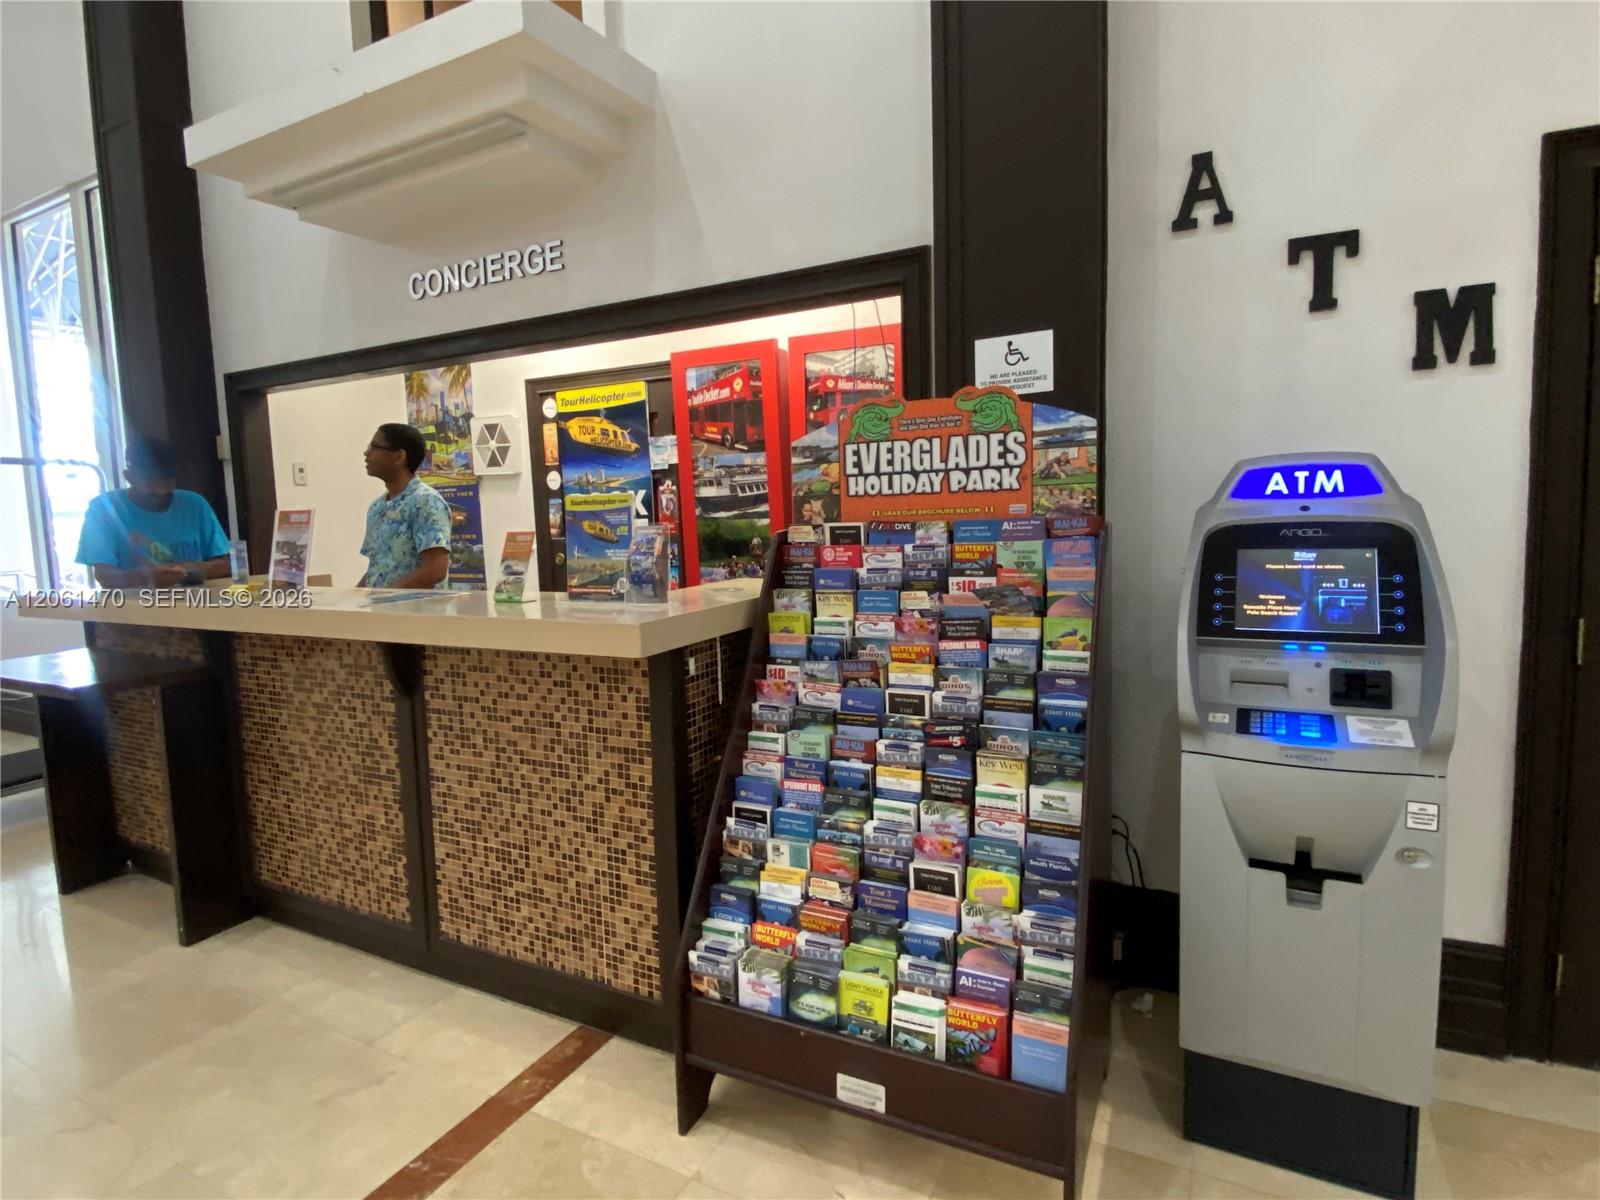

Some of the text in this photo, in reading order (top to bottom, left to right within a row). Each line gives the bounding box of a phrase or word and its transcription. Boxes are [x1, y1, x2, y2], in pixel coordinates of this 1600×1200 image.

[1172, 151, 1233, 232] A
[408, 240, 564, 300] CONCIERGE
[1288, 229, 1359, 312] T
[1412, 282, 1496, 371] M
[1011, 369, 1038, 377] PLEASED
[1013, 375, 1047, 383] ASSISTANCE
[578, 425, 596, 436] TOUR
[845, 431, 1026, 476] EVERGLADES
[848, 467, 1021, 497] HOLIDAY PARK
[1265, 469, 1345, 495] ATM
[894, 522, 912, 530] DIVE
[1280, 528, 1322, 537] ARGO
[890, 645, 930, 653] BUTTERFLY
[989, 743, 1020, 751] DINOS
[794, 760, 810, 768] Tour
[979, 759, 1024, 771] Key West
[1029, 859, 1073, 872] South Florida.
[756, 924, 797, 939] BUTTERFLY
[755, 933, 780, 946] WORLD
[947, 1008, 998, 1026] BUTTERFLY
[947, 1016, 979, 1030] WORLD
